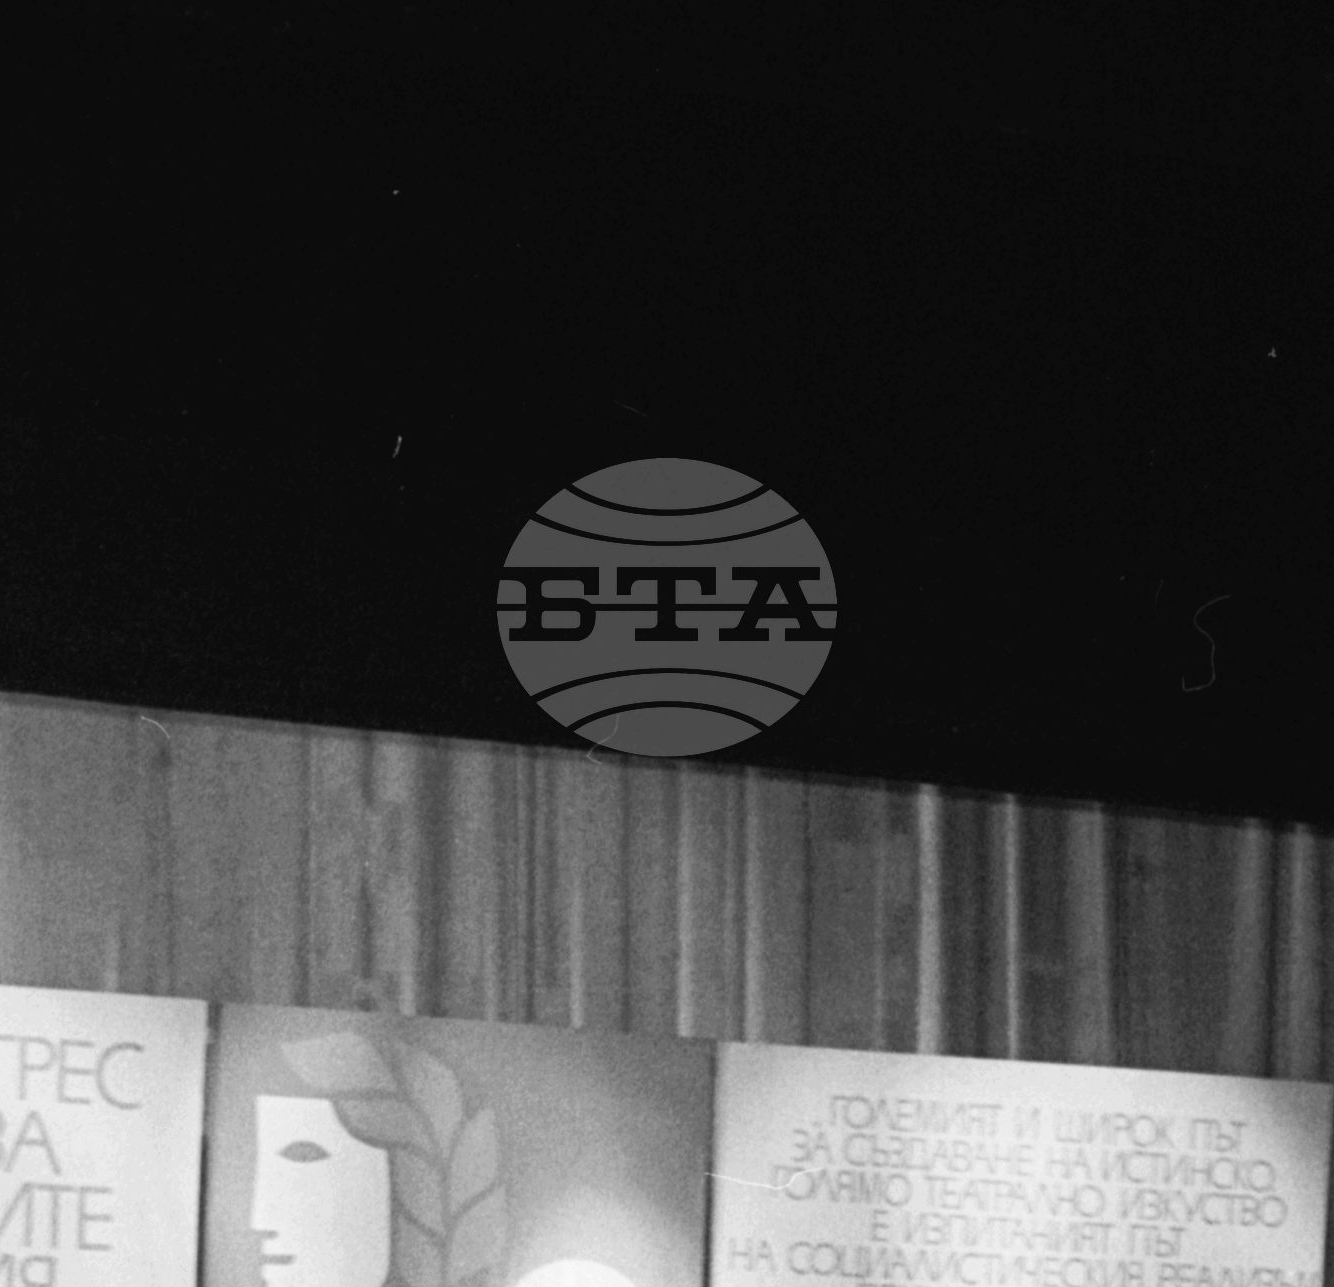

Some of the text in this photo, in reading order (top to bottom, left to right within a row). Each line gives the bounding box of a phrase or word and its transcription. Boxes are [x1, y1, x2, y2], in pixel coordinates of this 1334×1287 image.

[1015, 1105, 1041, 1138] И
[1054, 1111, 1176, 1148] ШИРОК
[1189, 1118, 1247, 1153] ПЪТ
[790, 1129, 1277, 1193] ЗА СЪЗДАВАНЕ НА ИСТИНСКО
[771, 1164, 1289, 1229] ГОЛЯМО ТЕАТРАЛНО ИЗКУСТВО
[726, 1238, 777, 1273] НА
[870, 1209, 890, 1243] Е
[1128, 1224, 1186, 1259] ПЪТ
